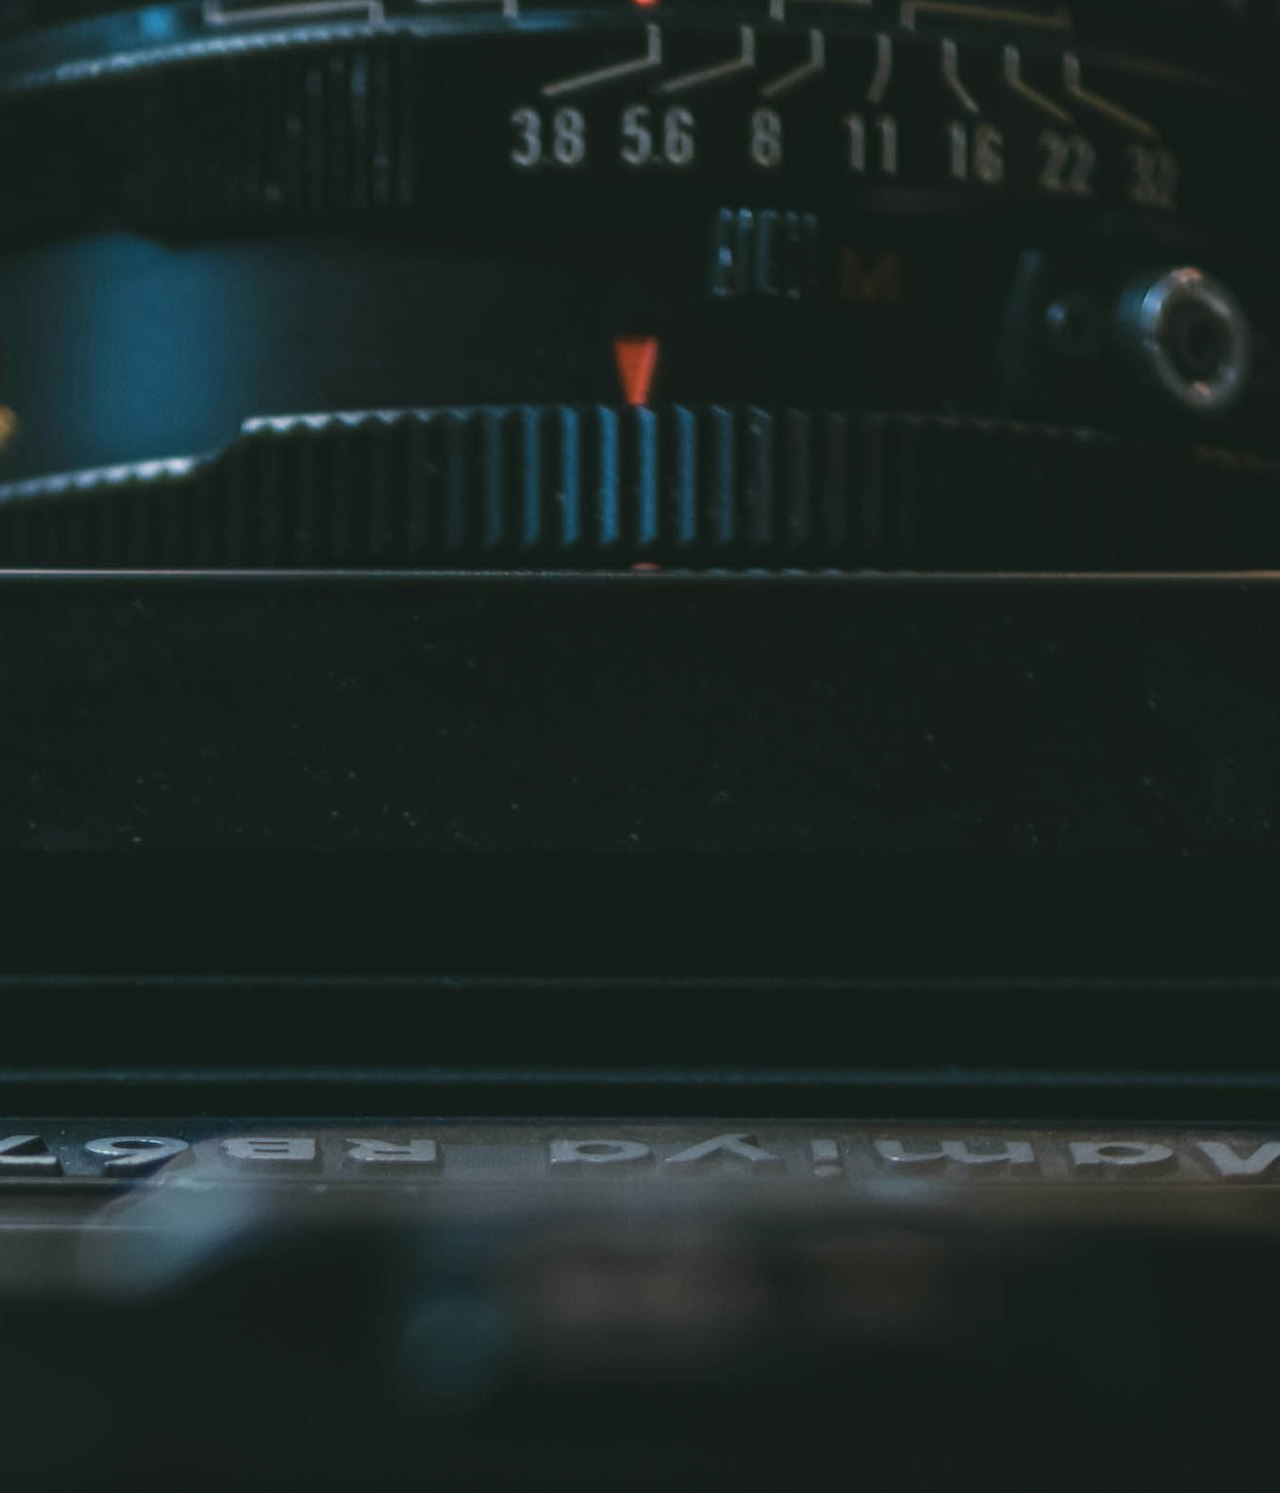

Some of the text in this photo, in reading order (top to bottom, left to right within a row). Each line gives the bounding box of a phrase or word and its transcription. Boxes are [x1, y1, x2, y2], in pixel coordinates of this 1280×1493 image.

[750, 106, 782, 167] 8
[842, 110, 898, 176] 11
[943, 116, 1005, 184] 16
[1037, 128, 1097, 197] 22
